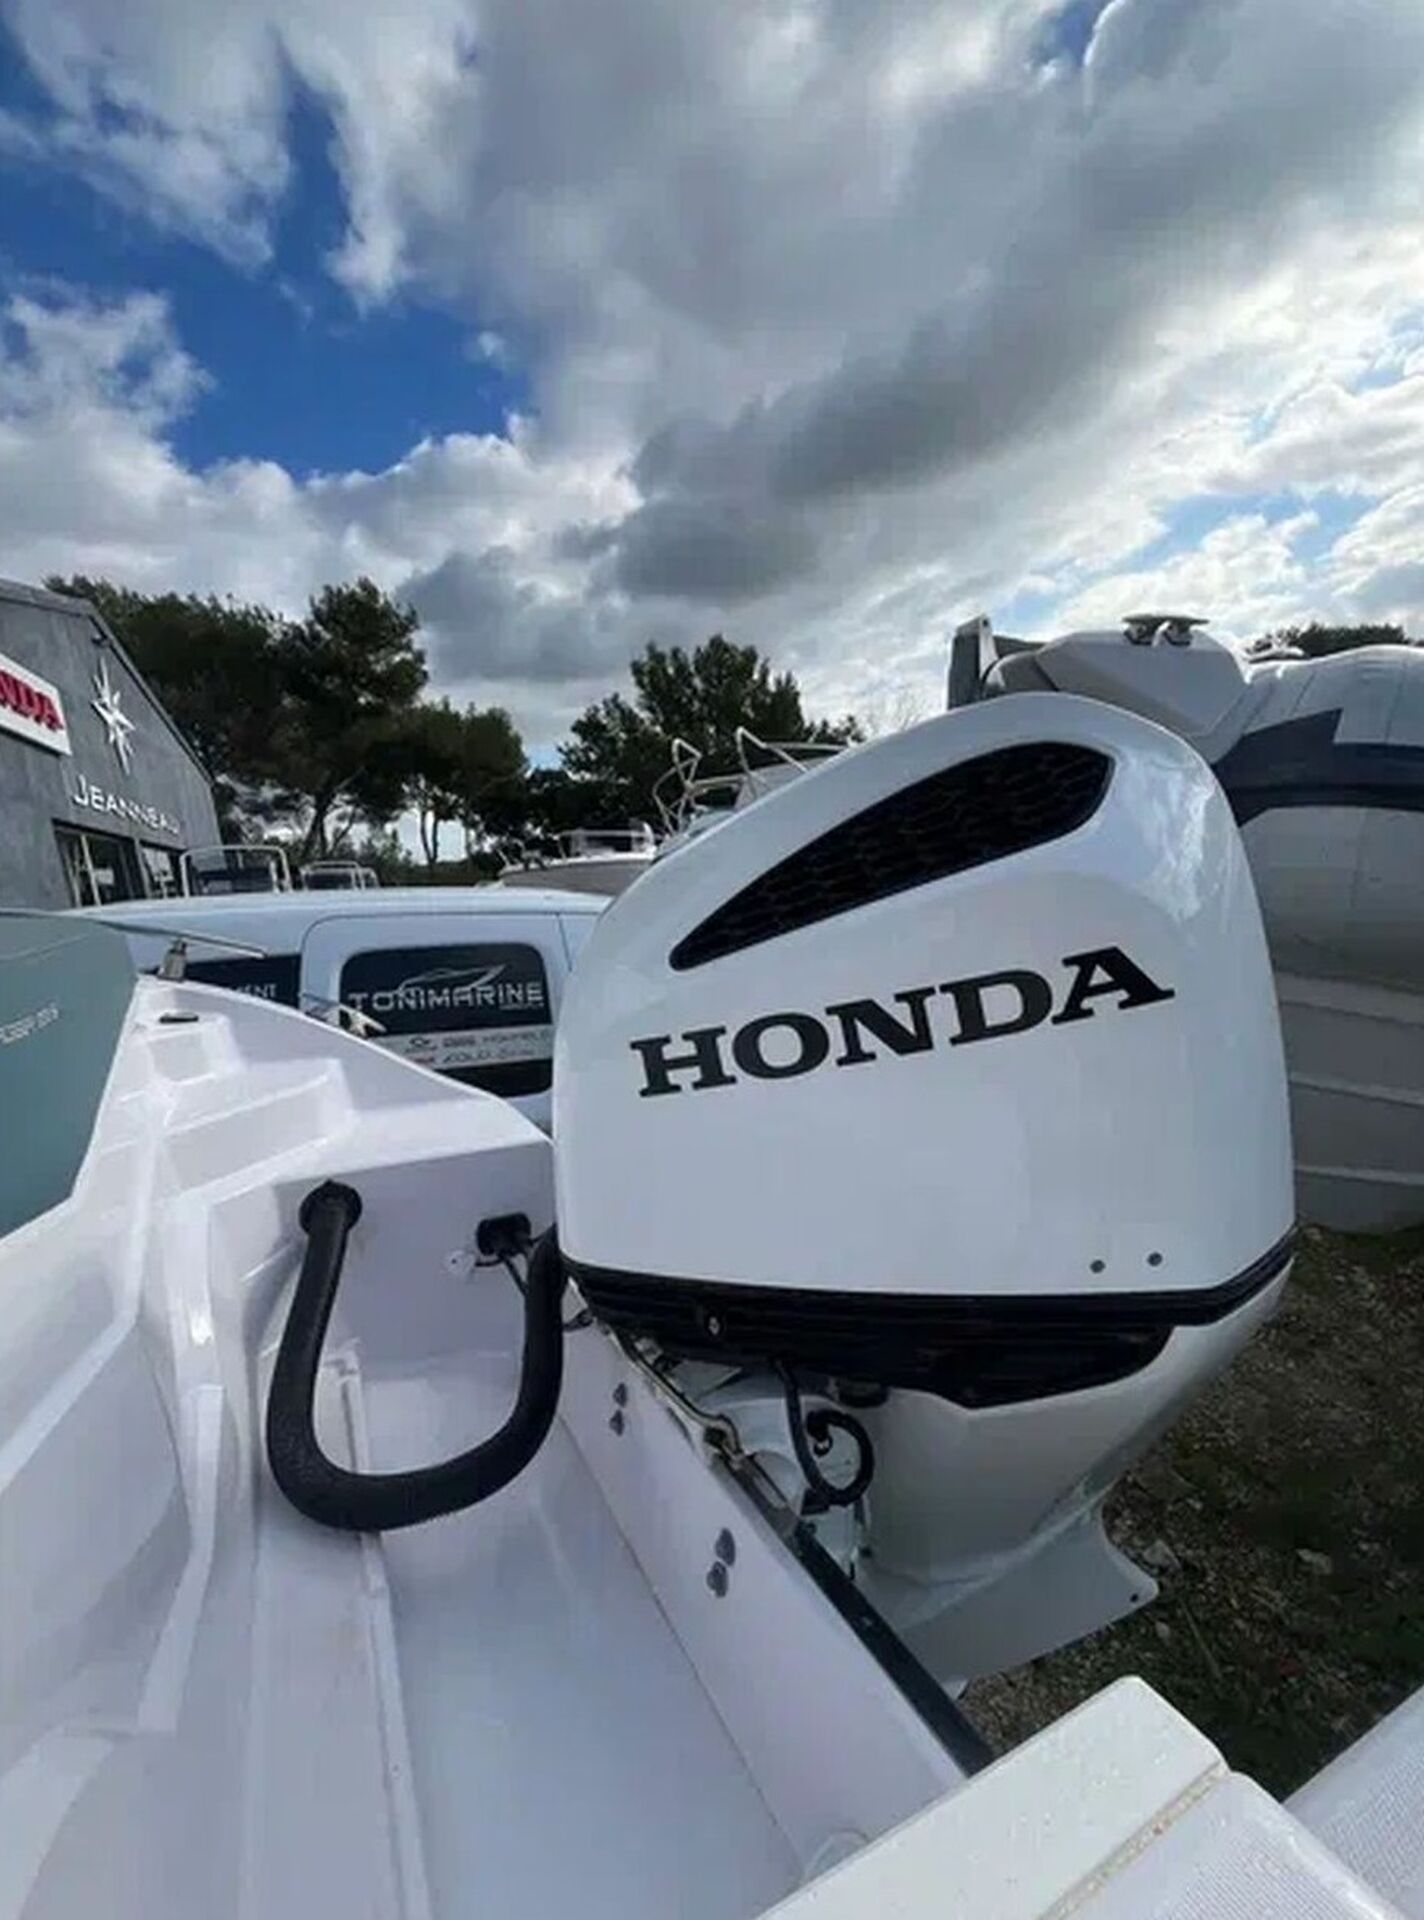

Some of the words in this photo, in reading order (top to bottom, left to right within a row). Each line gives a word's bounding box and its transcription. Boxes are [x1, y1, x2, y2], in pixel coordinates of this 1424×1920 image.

[73, 774, 179, 834] JEANNEAU
[349, 983, 544, 1012] TONIMARINE
[630, 946, 1175, 1096] HONDA
